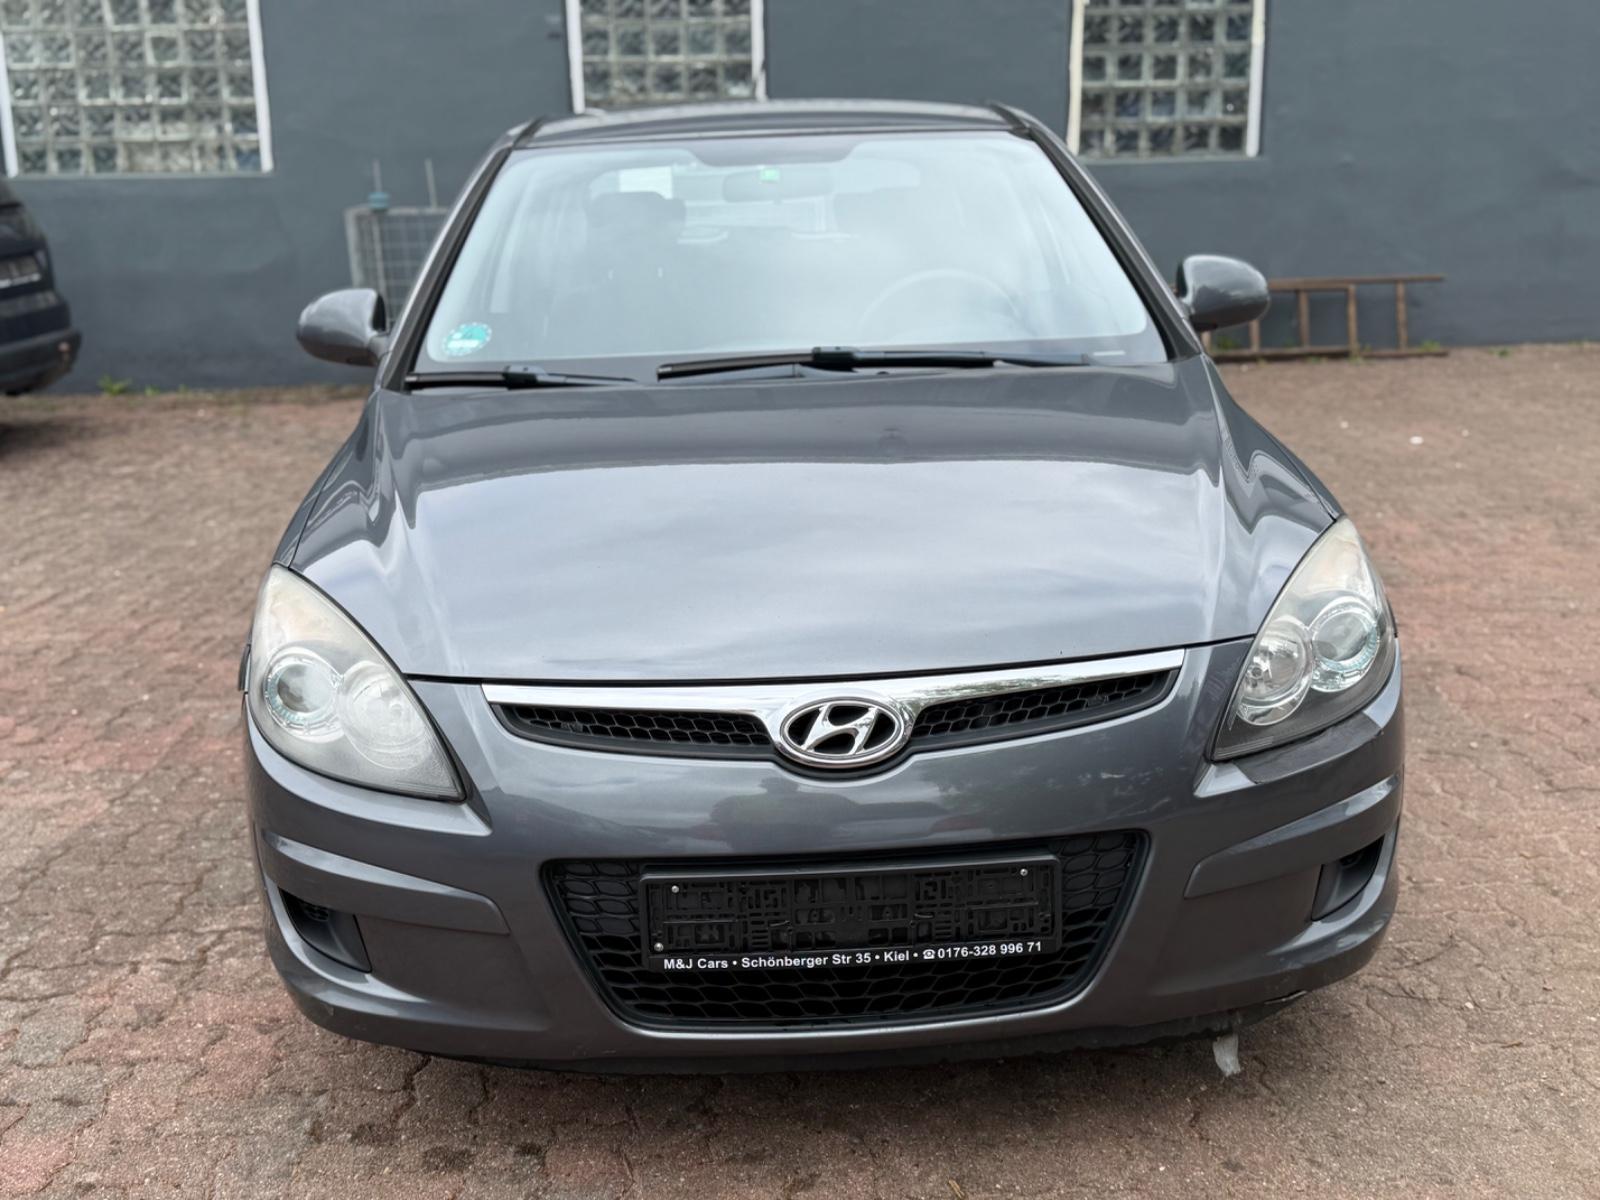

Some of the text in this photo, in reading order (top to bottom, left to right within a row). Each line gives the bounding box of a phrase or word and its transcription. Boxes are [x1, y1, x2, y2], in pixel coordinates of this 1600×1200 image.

[663, 941, 1041, 970] M&J Cars Schönberger Str 35 Kiel 0176-328 996 71
